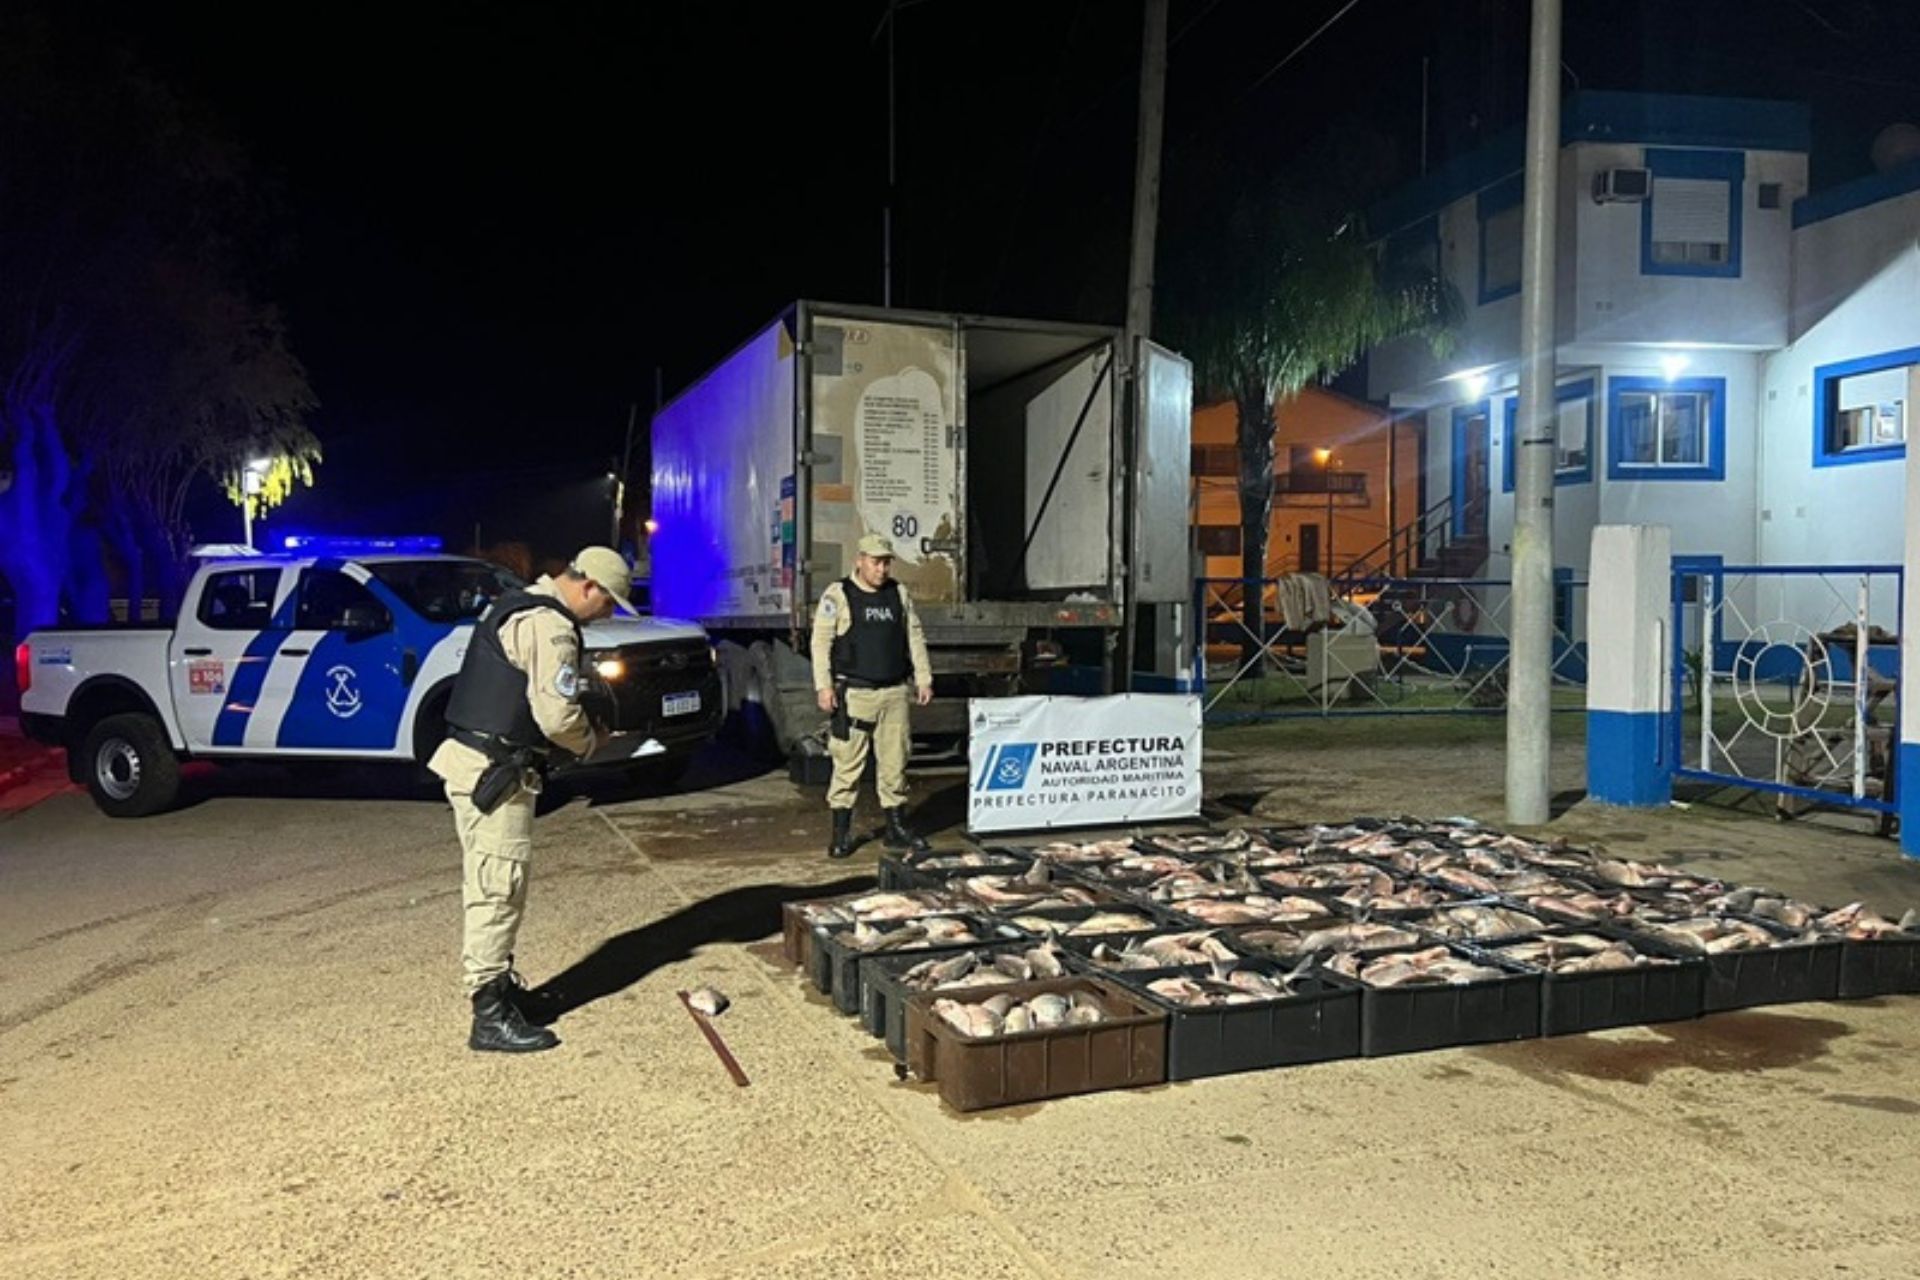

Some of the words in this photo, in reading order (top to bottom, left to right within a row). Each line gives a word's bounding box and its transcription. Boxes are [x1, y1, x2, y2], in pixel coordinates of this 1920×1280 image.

[892, 514, 917, 538] 80
[865, 607, 893, 621] PNA
[1041, 736, 1184, 757] PREFECTURA
[1041, 759, 1091, 774] NAVAL
[1095, 755, 1184, 771] ARGENTINA
[1041, 775, 1119, 787] AUTORIDAD
[1123, 771, 1184, 782] MARITIMA
[973, 793, 1080, 808] PREFECTURA
[1086, 786, 1186, 802] PARANACITO
